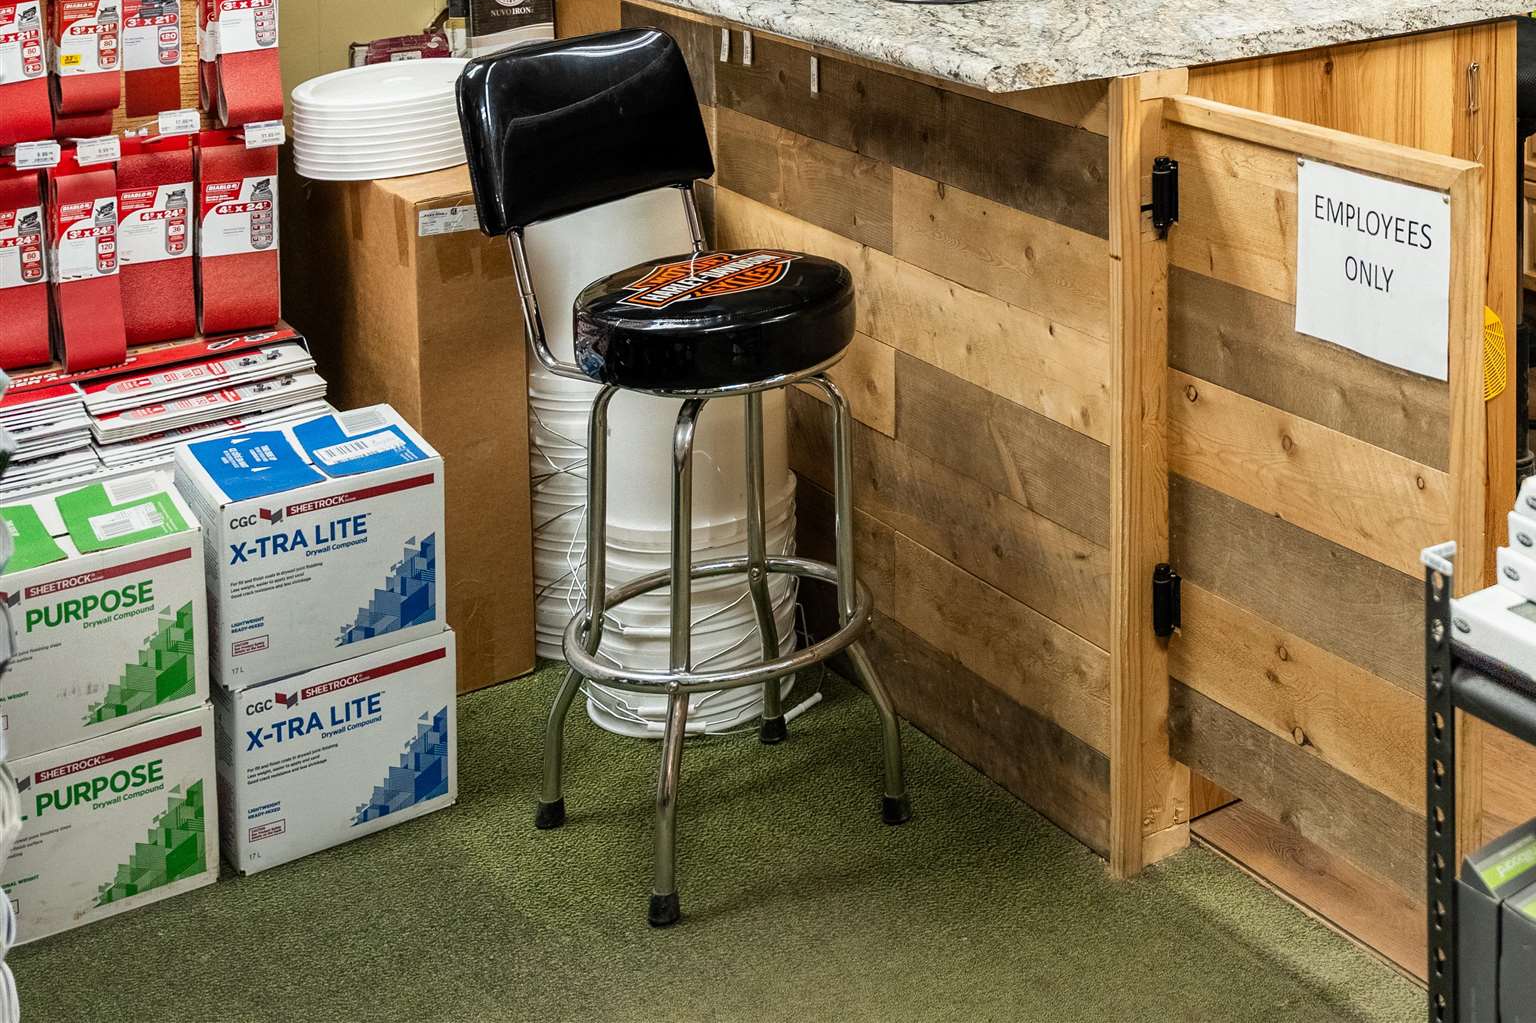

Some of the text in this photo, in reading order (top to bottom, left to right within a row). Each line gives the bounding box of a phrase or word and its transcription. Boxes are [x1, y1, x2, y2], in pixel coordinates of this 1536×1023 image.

[490, 6, 531, 16] NUVO IRON
[1314, 194, 1432, 250] EMPLOYEES
[1345, 256, 1394, 293] ONLY
[230, 495, 345, 530] CGC SHEETROCK
[230, 514, 368, 566] X-TRA LITE
[306, 536, 368, 558] Drywall Compound
[30, 575, 90, 596] SHEETROCK
[26, 580, 154, 632] PURPOSE
[83, 604, 155, 630] Drywall Compound
[246, 675, 360, 716] CGC SHEETROCK
[246, 692, 382, 752] X-TRA LITE
[321, 716, 382, 739] Drywall Compound
[40, 757, 100, 782] SHEETROCK
[36, 759, 164, 816] PURPOSE
[92, 784, 164, 810] Drywall Compound
